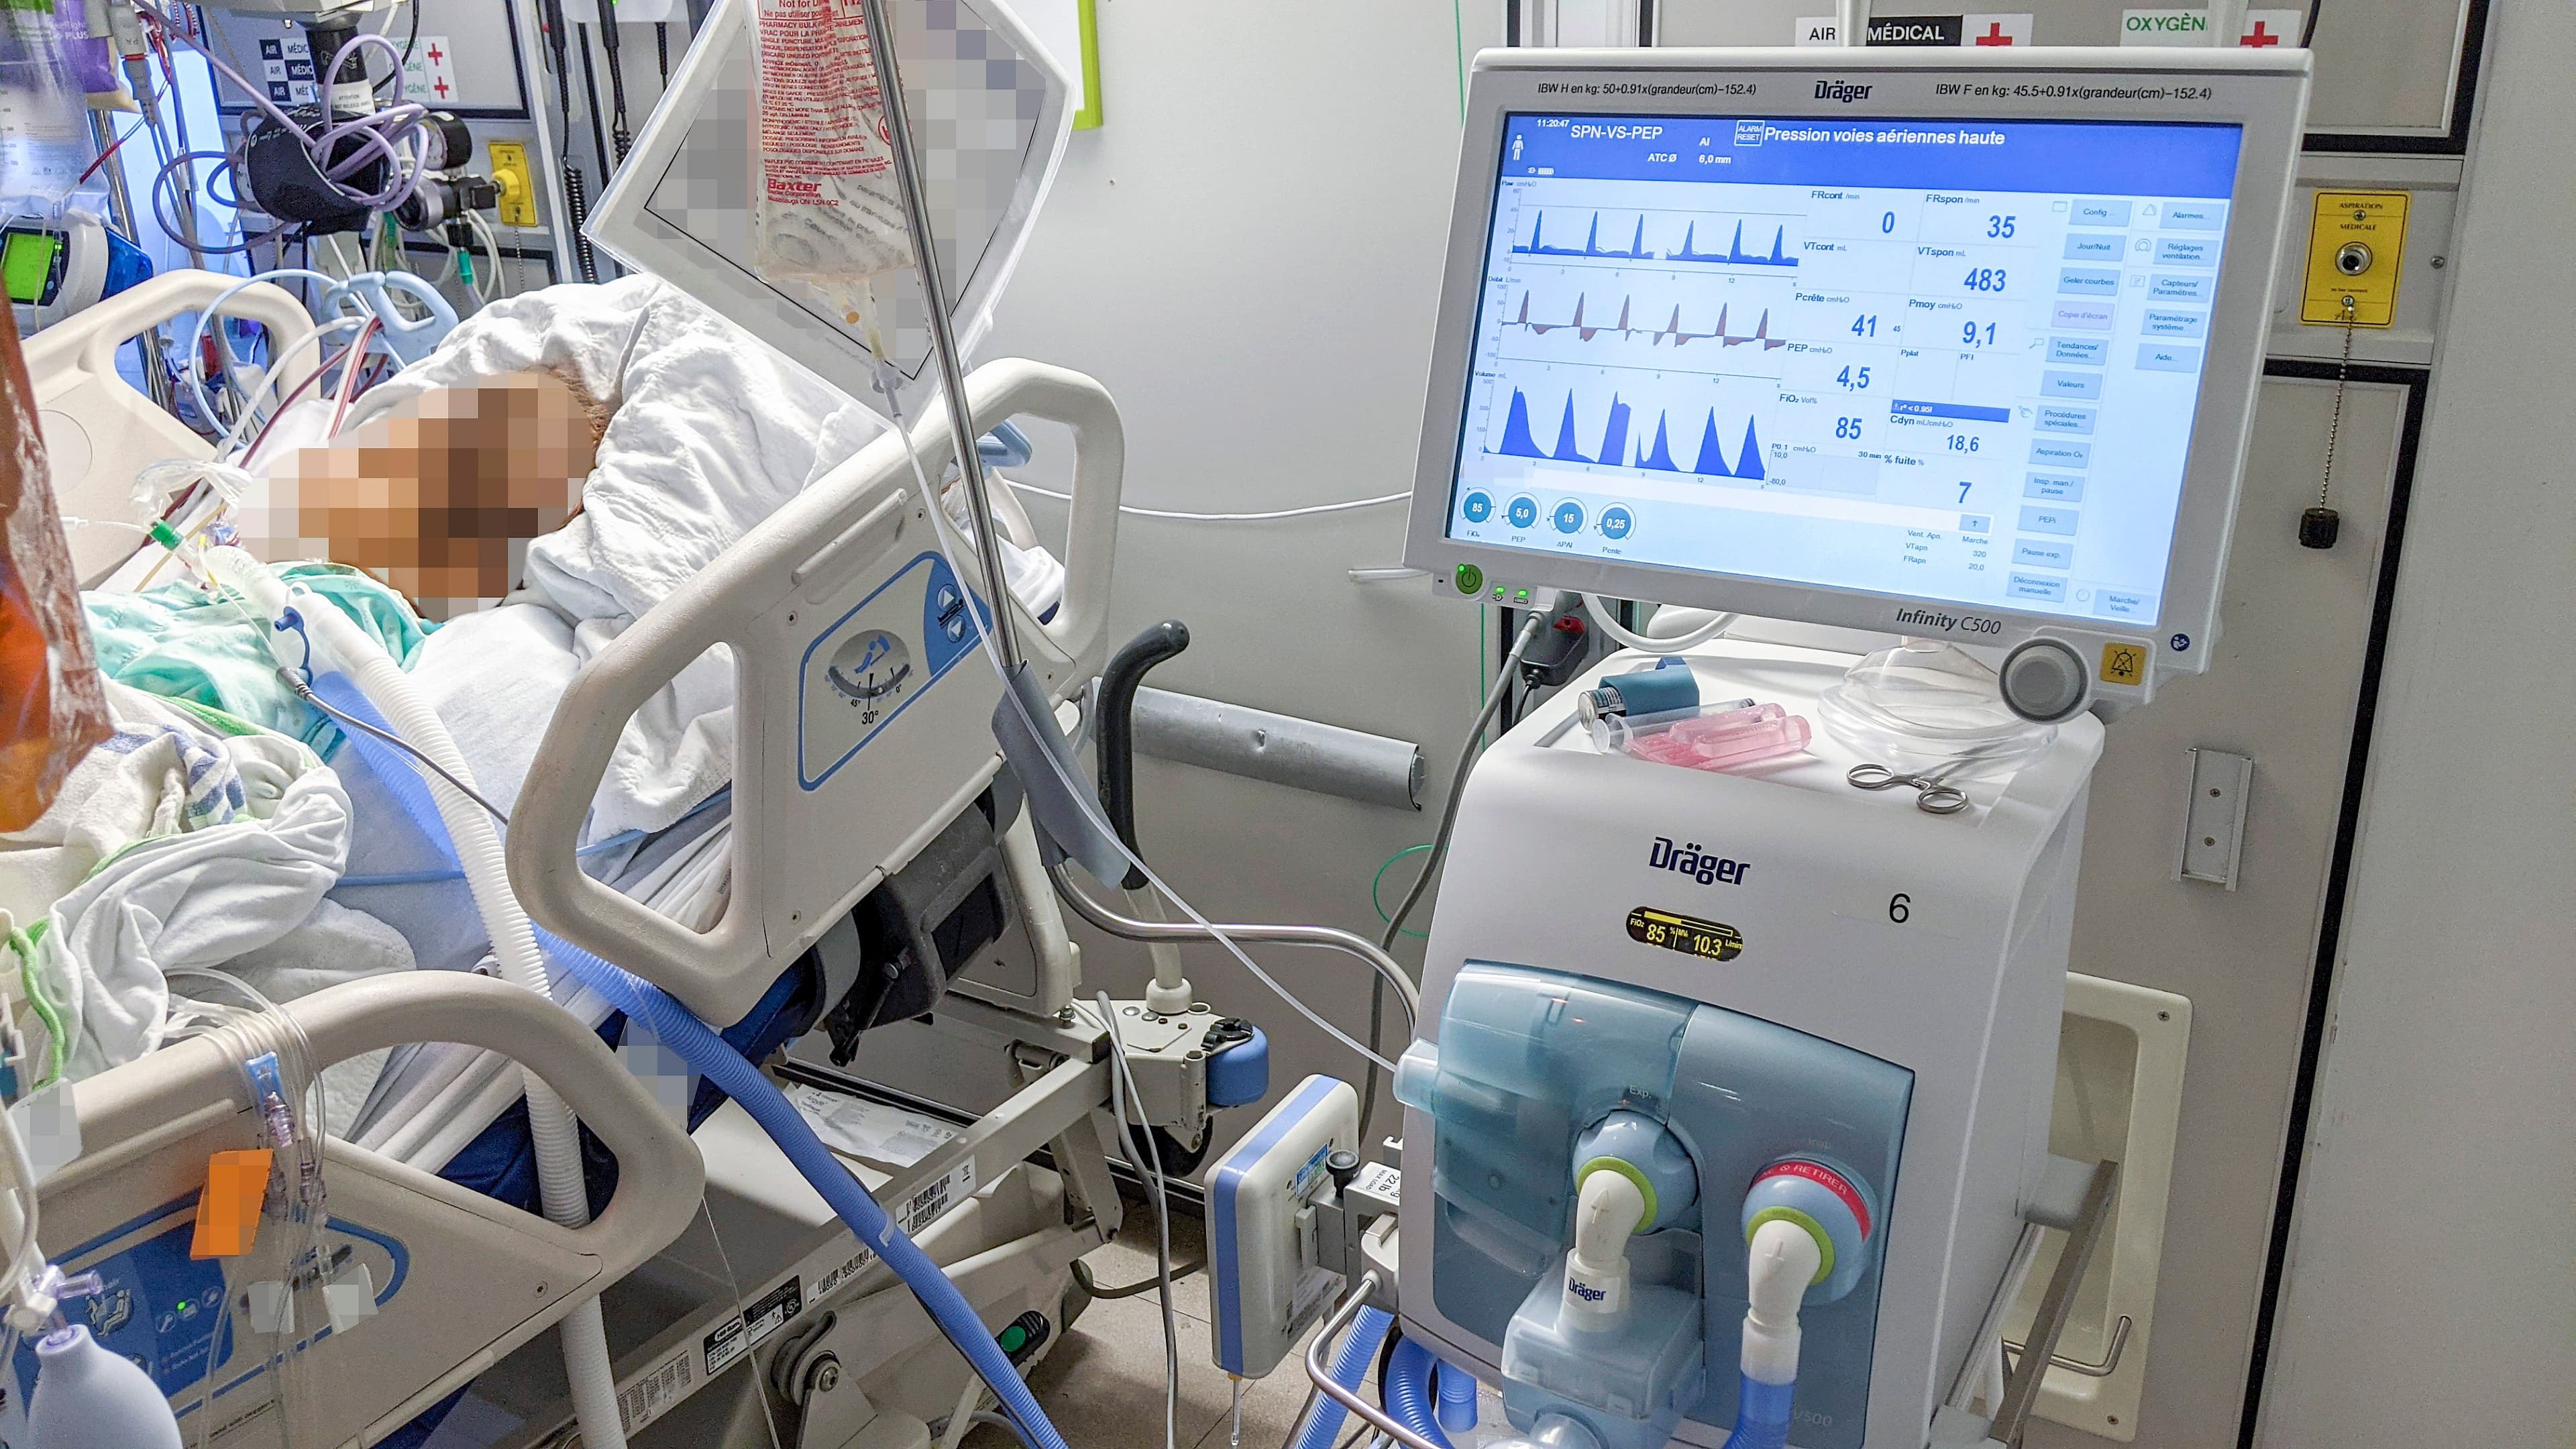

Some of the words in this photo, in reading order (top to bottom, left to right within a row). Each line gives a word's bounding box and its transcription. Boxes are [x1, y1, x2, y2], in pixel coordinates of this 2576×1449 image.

[2126, 13, 2208, 31] OXYGÈN
[1809, 28, 1835, 40] AIR
[1868, 23, 1945, 41] MÉDICAL
[1538, 83, 1558, 93] IBW
[1560, 84, 1569, 93] H
[1571, 86, 1583, 94] en
[1585, 84, 1601, 95] kg:
[1814, 80, 1872, 103] Dräger
[1936, 84, 1961, 95] IBW
[1964, 85, 1973, 95] F
[1975, 87, 1989, 97] en
[1992, 85, 2010, 98] kg:
[1536, 119, 1570, 128] 11:20:47
[1570, 125, 1663, 140] SPN-VS-PEP
[1737, 133, 1760, 141] RESET
[1764, 127, 1830, 142] Pression
[1833, 129, 1874, 142] voies
[1877, 129, 1956, 144] aériennes
[1959, 131, 2005, 145] haute
[1647, 153, 1668, 162] ATC
[767, 178, 822, 192] Baxter
[1811, 191, 1843, 199] FRcont
[1926, 195, 1964, 205] FRspon
[1882, 211, 1894, 233] 0
[1987, 214, 2016, 239] 35
[1804, 241, 1834, 251] VTcont
[2078, 243, 2110, 251] Jour/Nuit
[2167, 244, 2203, 252] Réglages
[1917, 247, 1954, 257] VTspon
[1964, 268, 2006, 292] 483
[2084, 278, 2114, 286] courbes
[2162, 279, 2198, 288] Capteurs/
[1795, 292, 1825, 302] Pcrête
[1909, 299, 1935, 310] Pmoy
[2058, 311, 2079, 319] Copie
[2080, 311, 2108, 319] d'écran
[2149, 314, 2198, 323] Paramétrage
[1851, 314, 1877, 337] 41
[1963, 321, 1996, 348] 9,1
[1787, 343, 1808, 353] PEP
[2057, 341, 2098, 351] Tendances/
[1901, 349, 1919, 357] Pplat
[1837, 365, 1871, 391] 4,5
[2057, 380, 2084, 388] Valeurs
[1890, 415, 1915, 426] Cdyn
[2045, 410, 2086, 420] Procédures
[1835, 417, 1862, 440] 85
[1947, 435, 1980, 453] 18,6
[2036, 447, 2071, 457] Aspiration
[1884, 455, 1892, 464] %
[1895, 456, 1916, 466] fuite
[1959, 482, 1972, 504] 7
[1472, 504, 1483, 513] 85
[1515, 508, 1529, 519] 5,0
[1564, 514, 1574, 523] 15
[1607, 519, 1625, 530] 0,25
[1962, 536, 1988, 545] Marche
[1906, 543, 1928, 551] VTapn
[2022, 548, 2044, 557] Pause
[1903, 555, 1926, 564] FRapn
[2014, 576, 2059, 588] Déconnexion
[2019, 586, 2051, 596] manuelle
[1896, 608, 1957, 631] Infinity
[1961, 616, 2001, 634] C500
[862, 710, 878, 724] 30°
[1649, 837, 1750, 885] Dräger
[1888, 893, 1911, 923] 6
[1646, 924, 1666, 943] 85
[1694, 934, 1722, 956] 10.3
[1629, 1085, 1652, 1099] Exp.
[1385, 1174, 1399, 1185] 22
[1793, 1165, 1847, 1195] RETIRER
[1568, 1277, 1606, 1303] Dräger
